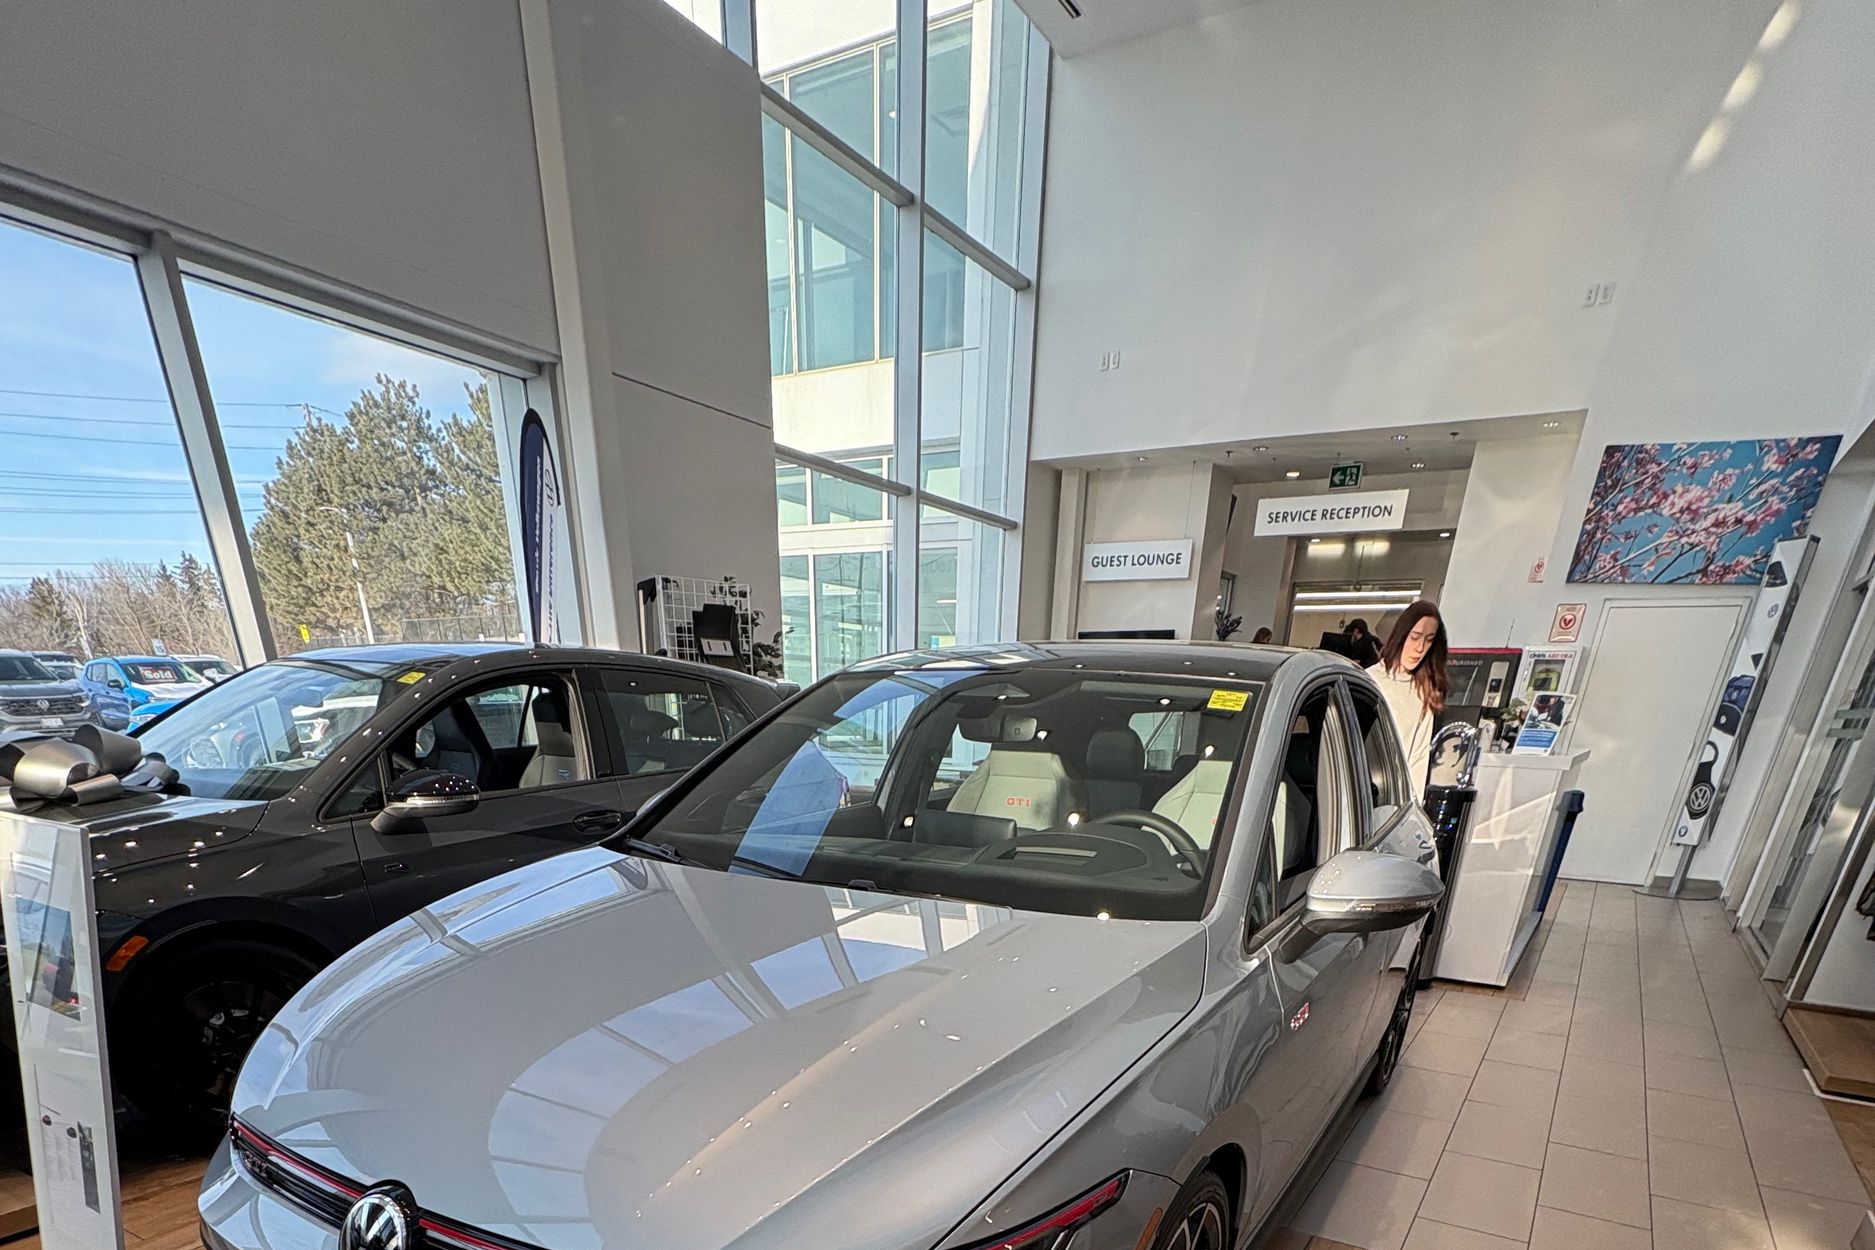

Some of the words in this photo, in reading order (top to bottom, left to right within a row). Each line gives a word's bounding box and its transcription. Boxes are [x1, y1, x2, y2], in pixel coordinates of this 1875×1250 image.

[1267, 509, 1317, 524] SERVICE
[1320, 504, 1393, 520] RECEPTION
[1091, 554, 1128, 568] GUEST
[1131, 552, 1183, 566] LOUNGE
[144, 670, 173, 680] Sold
